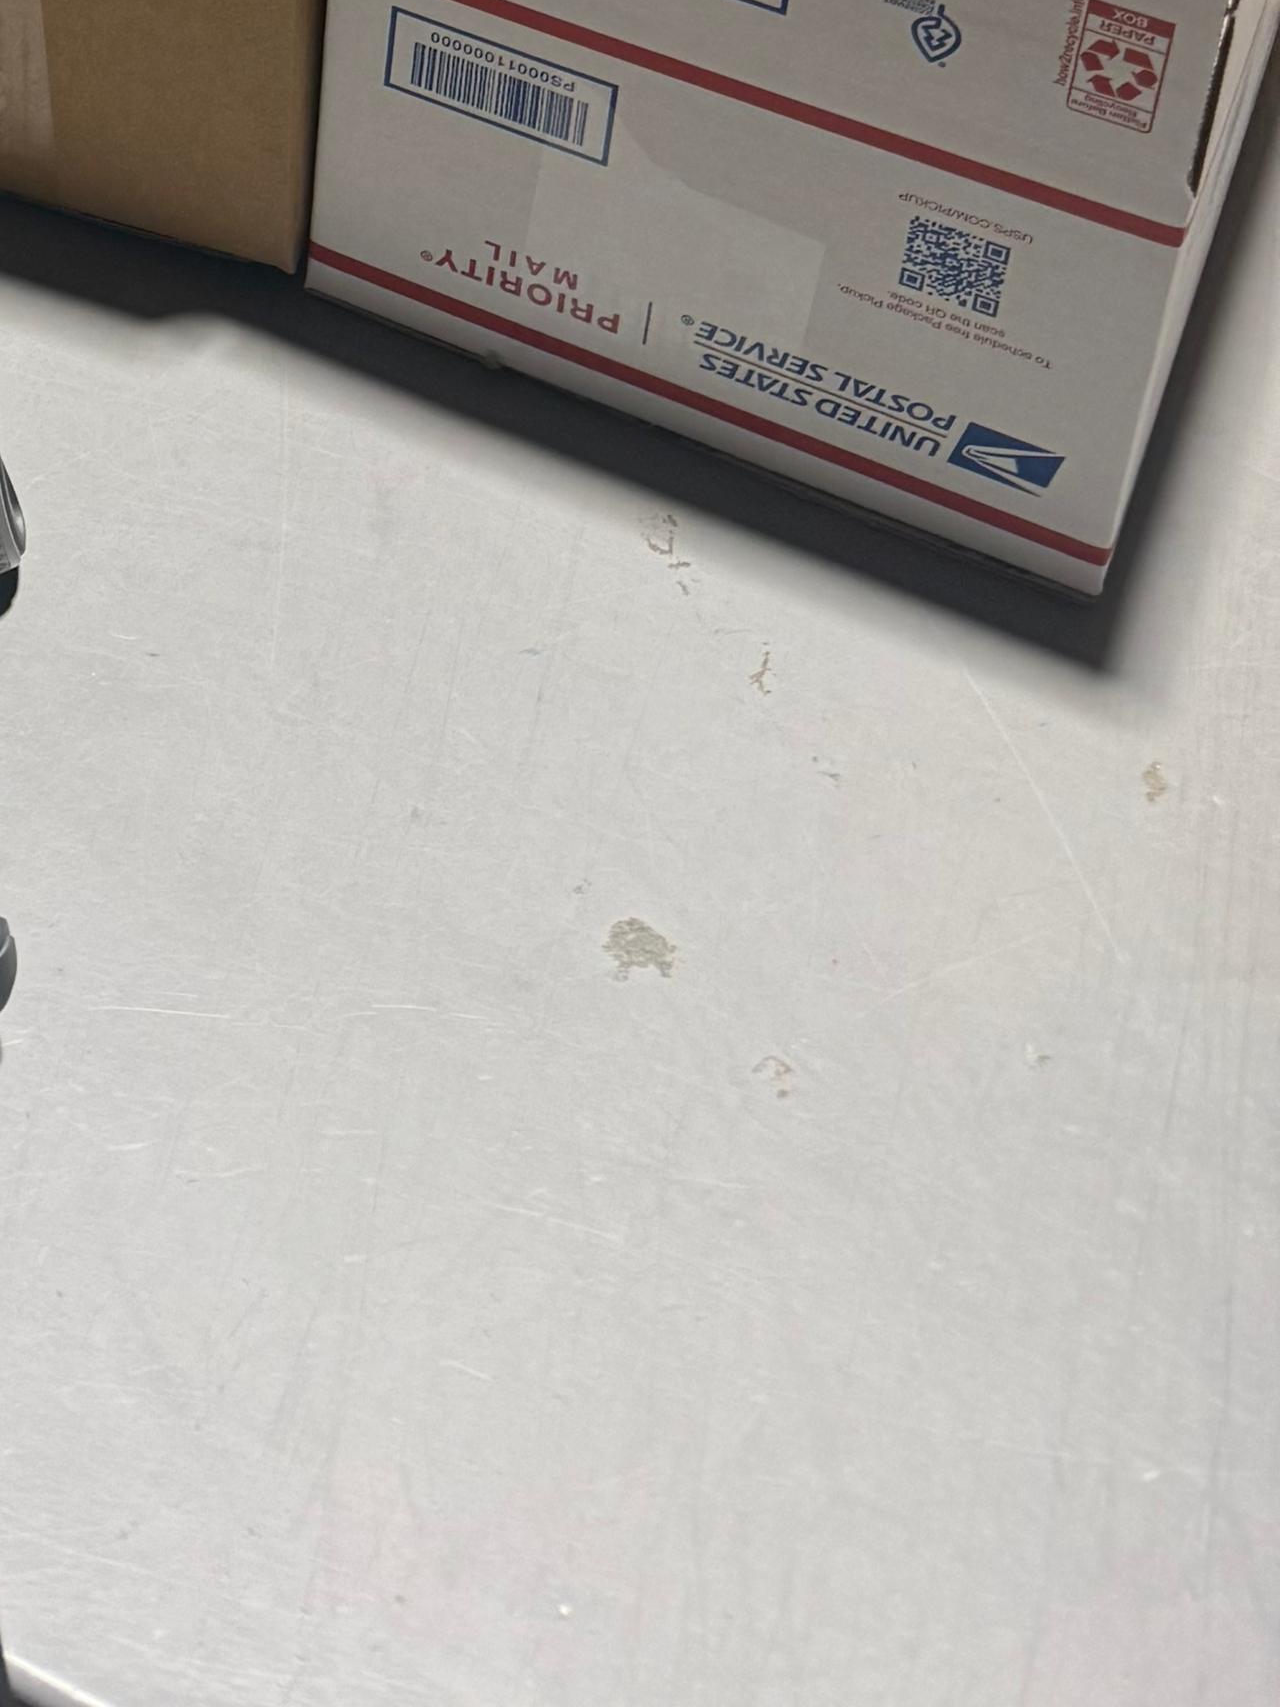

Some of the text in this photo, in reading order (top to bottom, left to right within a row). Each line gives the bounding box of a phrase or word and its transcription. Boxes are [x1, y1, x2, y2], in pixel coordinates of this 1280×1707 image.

[1099, 20, 1157, 46] PAPER
[1112, 8, 1150, 29] BOX
[430, 31, 576, 93] PS00011000000
[897, 192, 1035, 245] USPS.COM/PICKUP
[480, 240, 580, 291] MAIL
[836, 283, 1053, 370] To schedule free Package Pickup.
[886, 291, 1006, 339] scan the QR code.
[697, 352, 943, 457] UNITED STATES
[834, 369, 959, 432] POSTAL
